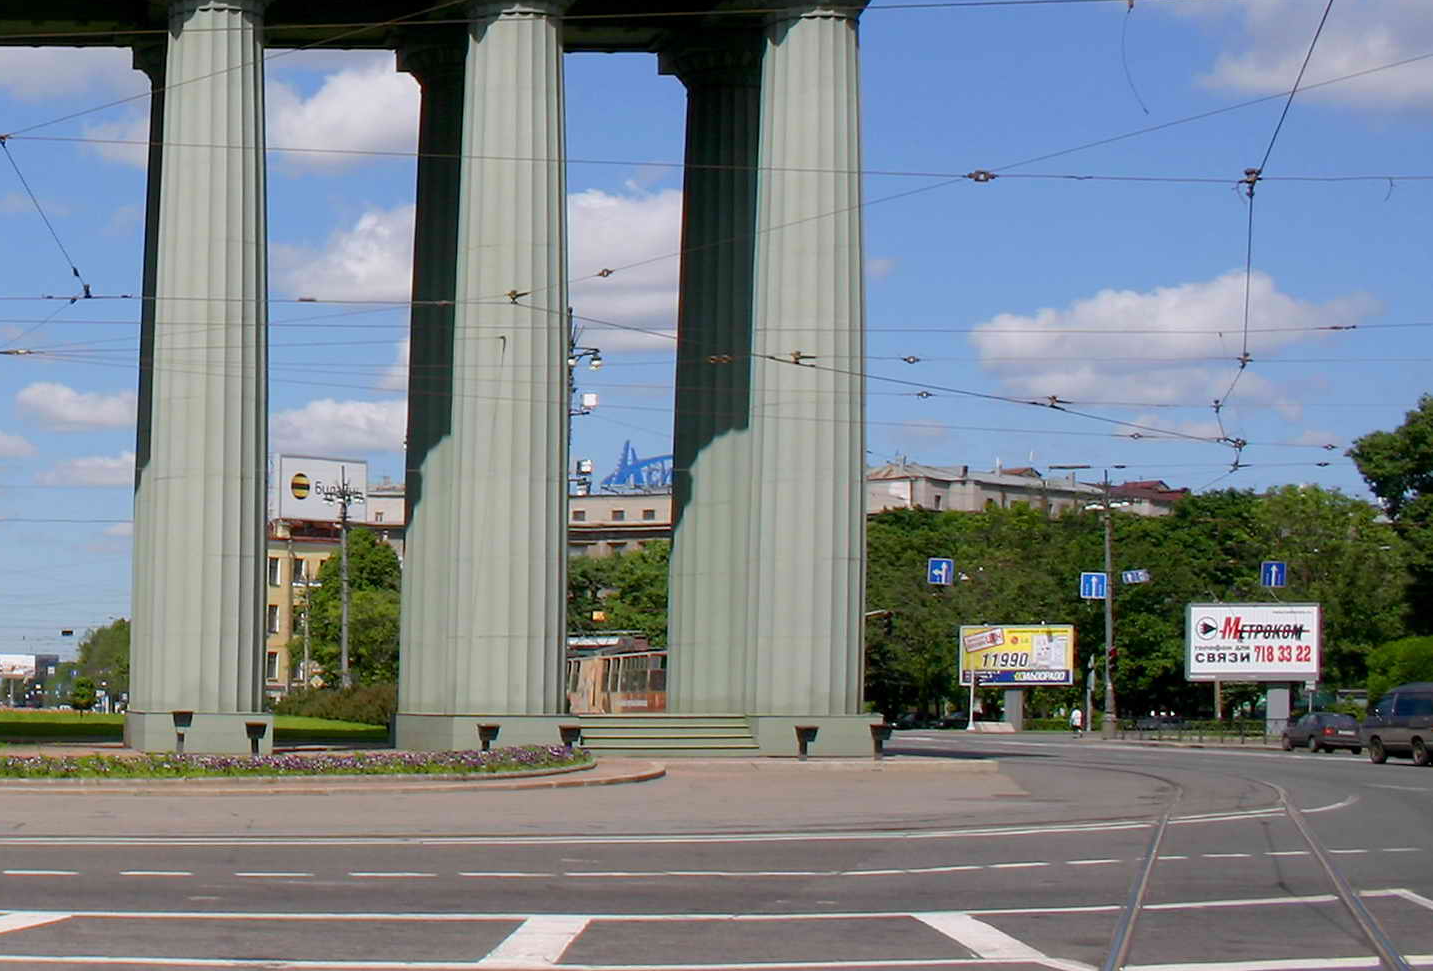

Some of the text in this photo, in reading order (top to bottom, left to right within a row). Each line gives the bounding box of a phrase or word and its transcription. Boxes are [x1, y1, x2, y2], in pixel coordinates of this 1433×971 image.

[982, 652, 1029, 668] 11990
[1254, 645, 1312, 662] 718 33 22
